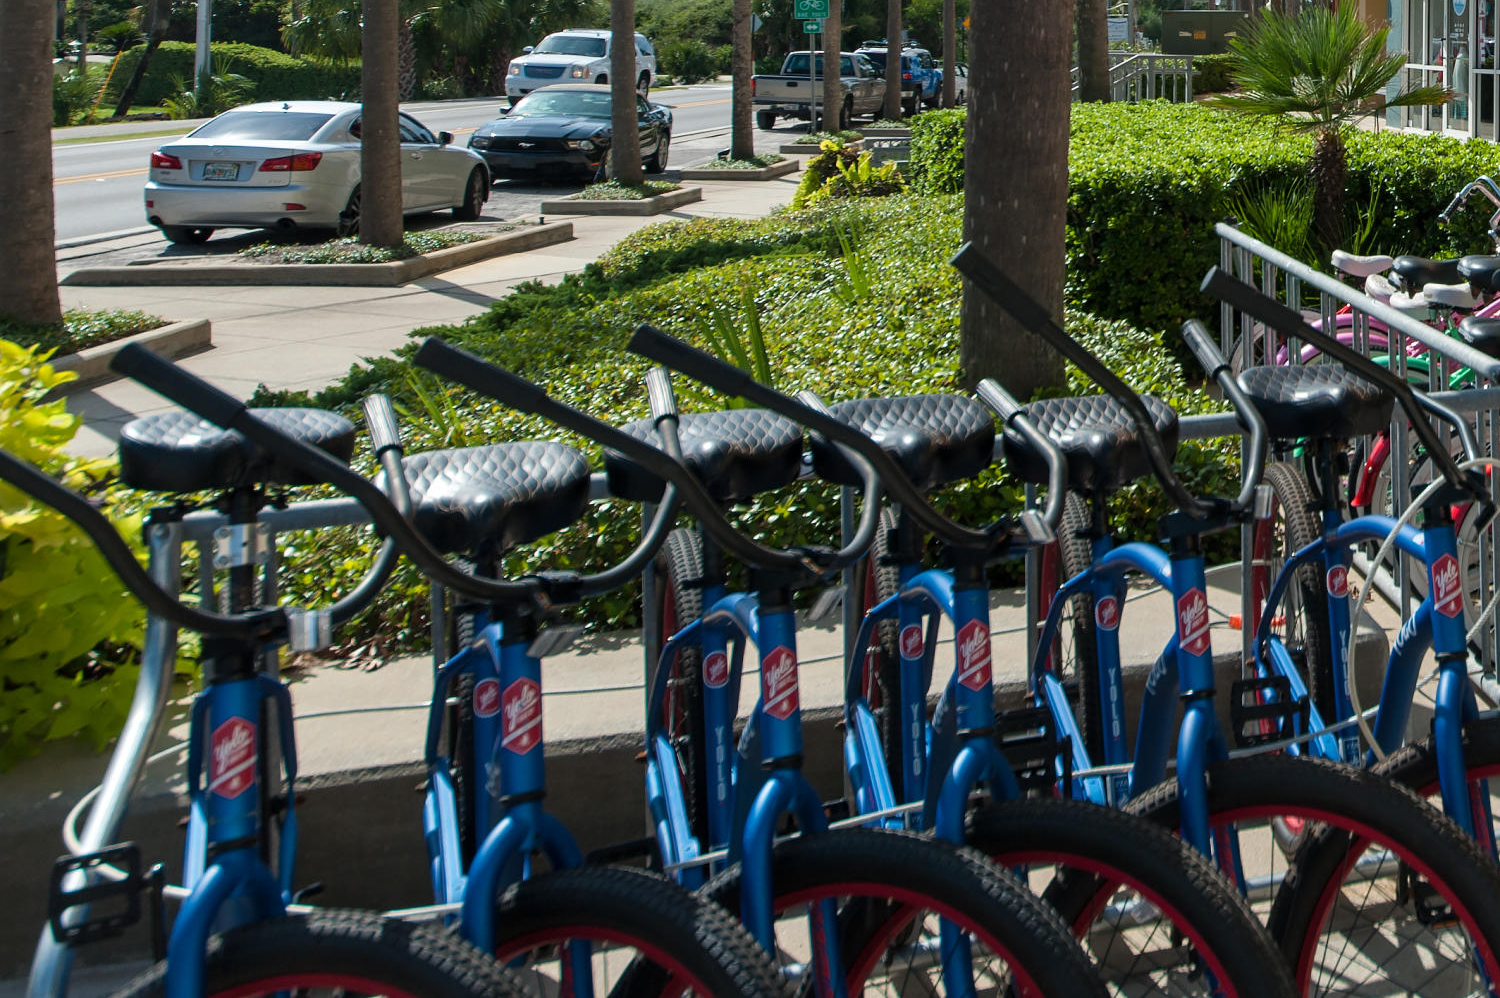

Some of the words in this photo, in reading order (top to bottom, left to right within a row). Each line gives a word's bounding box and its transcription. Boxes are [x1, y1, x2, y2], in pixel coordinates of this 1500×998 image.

[1435, 559, 1459, 600] Yolo
[1182, 593, 1205, 637] Yolo
[1108, 666, 1120, 738] YOLO
[910, 703, 922, 776] YOLO
